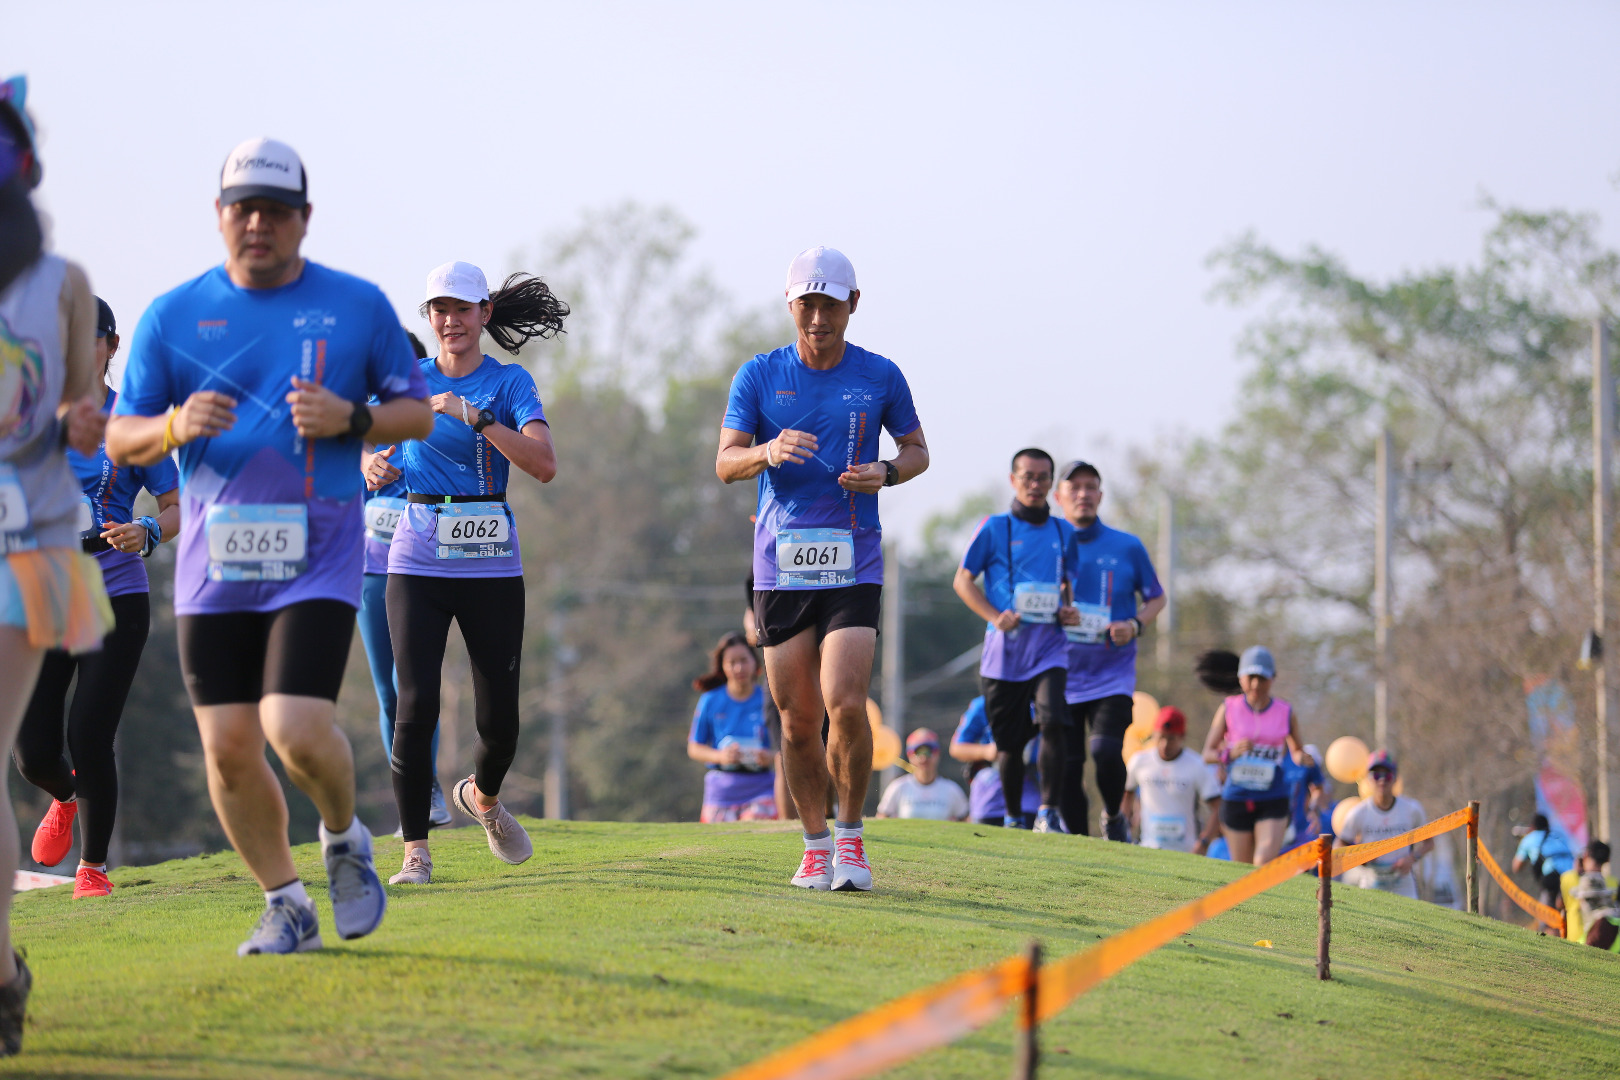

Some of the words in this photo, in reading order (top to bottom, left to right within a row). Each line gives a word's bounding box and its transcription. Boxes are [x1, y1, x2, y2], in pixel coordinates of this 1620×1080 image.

[849, 411, 857, 440] CROSS
[856, 412, 867, 448] SINGHA
[476, 442, 484, 480] COUNTRY
[485, 450, 493, 473] PARK
[486, 475, 494, 496] CHIA
[376, 512, 399, 530] 612
[452, 519, 499, 539] 6062
[226, 528, 289, 554] 6365
[793, 546, 838, 566] 6061
